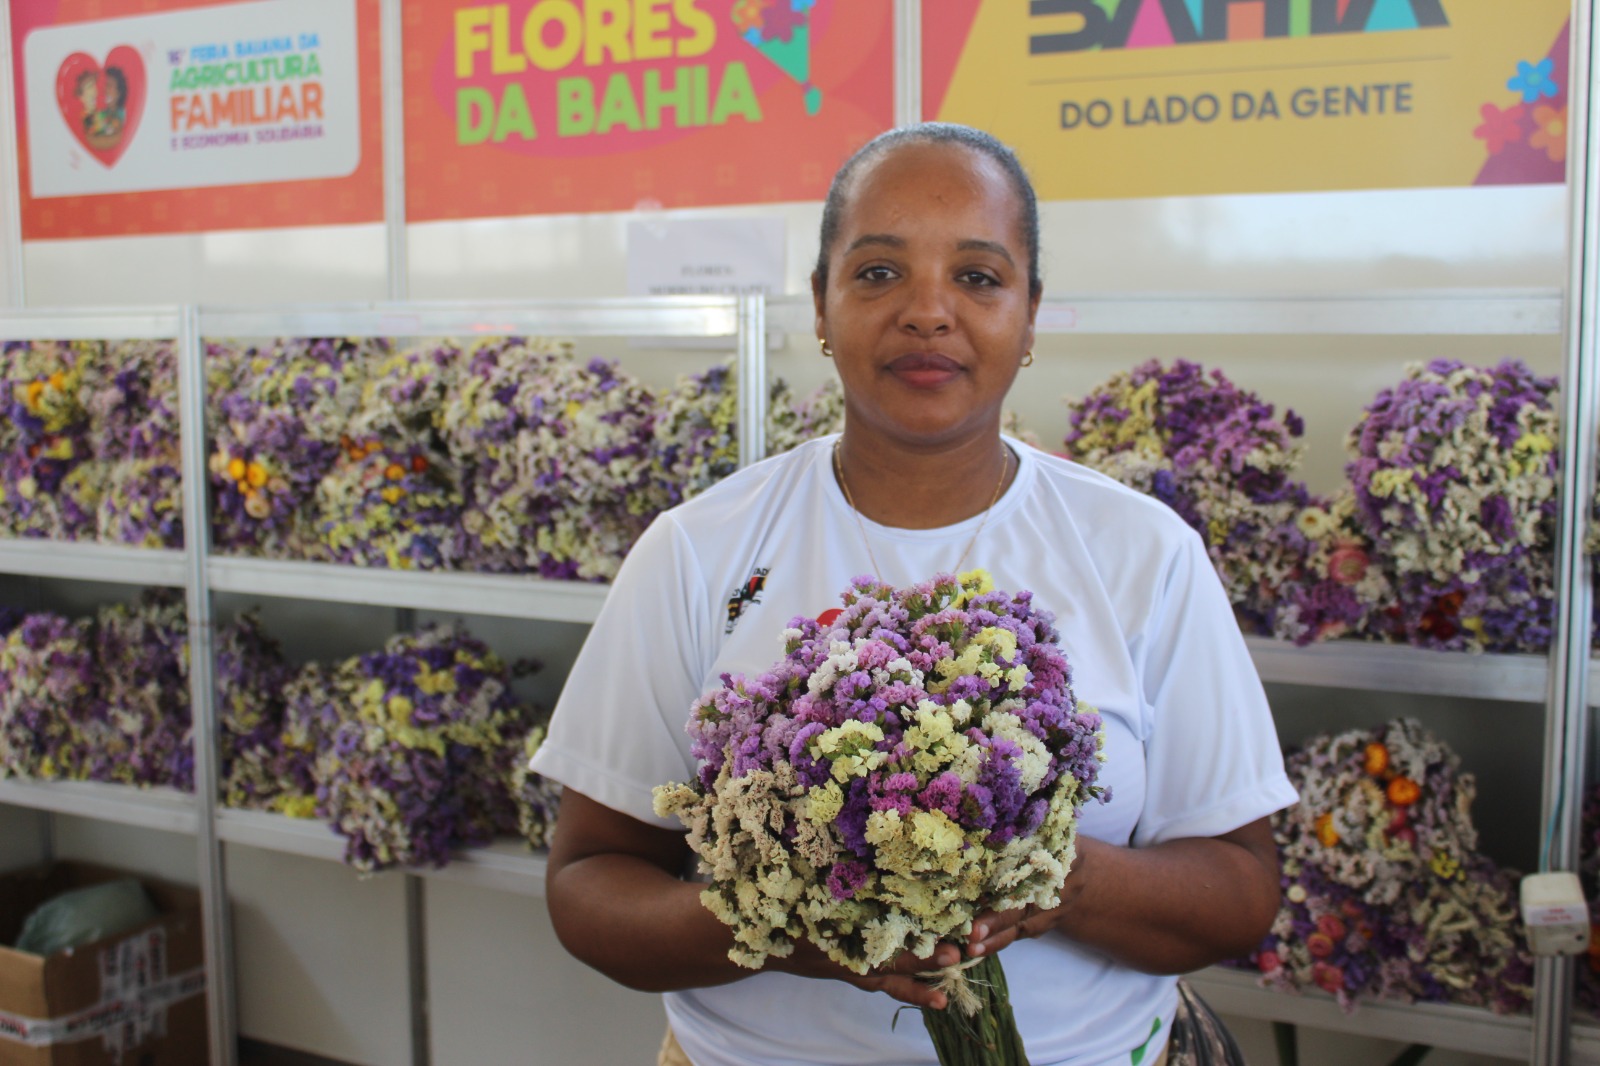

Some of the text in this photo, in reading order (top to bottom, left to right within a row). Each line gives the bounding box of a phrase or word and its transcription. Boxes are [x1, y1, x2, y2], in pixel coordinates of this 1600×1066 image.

[454, 0, 717, 79] FLORES
[170, 52, 321, 91] AGRICULTURA
[170, 80, 324, 132] FAMILIAR
[455, 61, 764, 146] DA BAHIA
[1060, 82, 1413, 131] DO LADO DA GENTE
